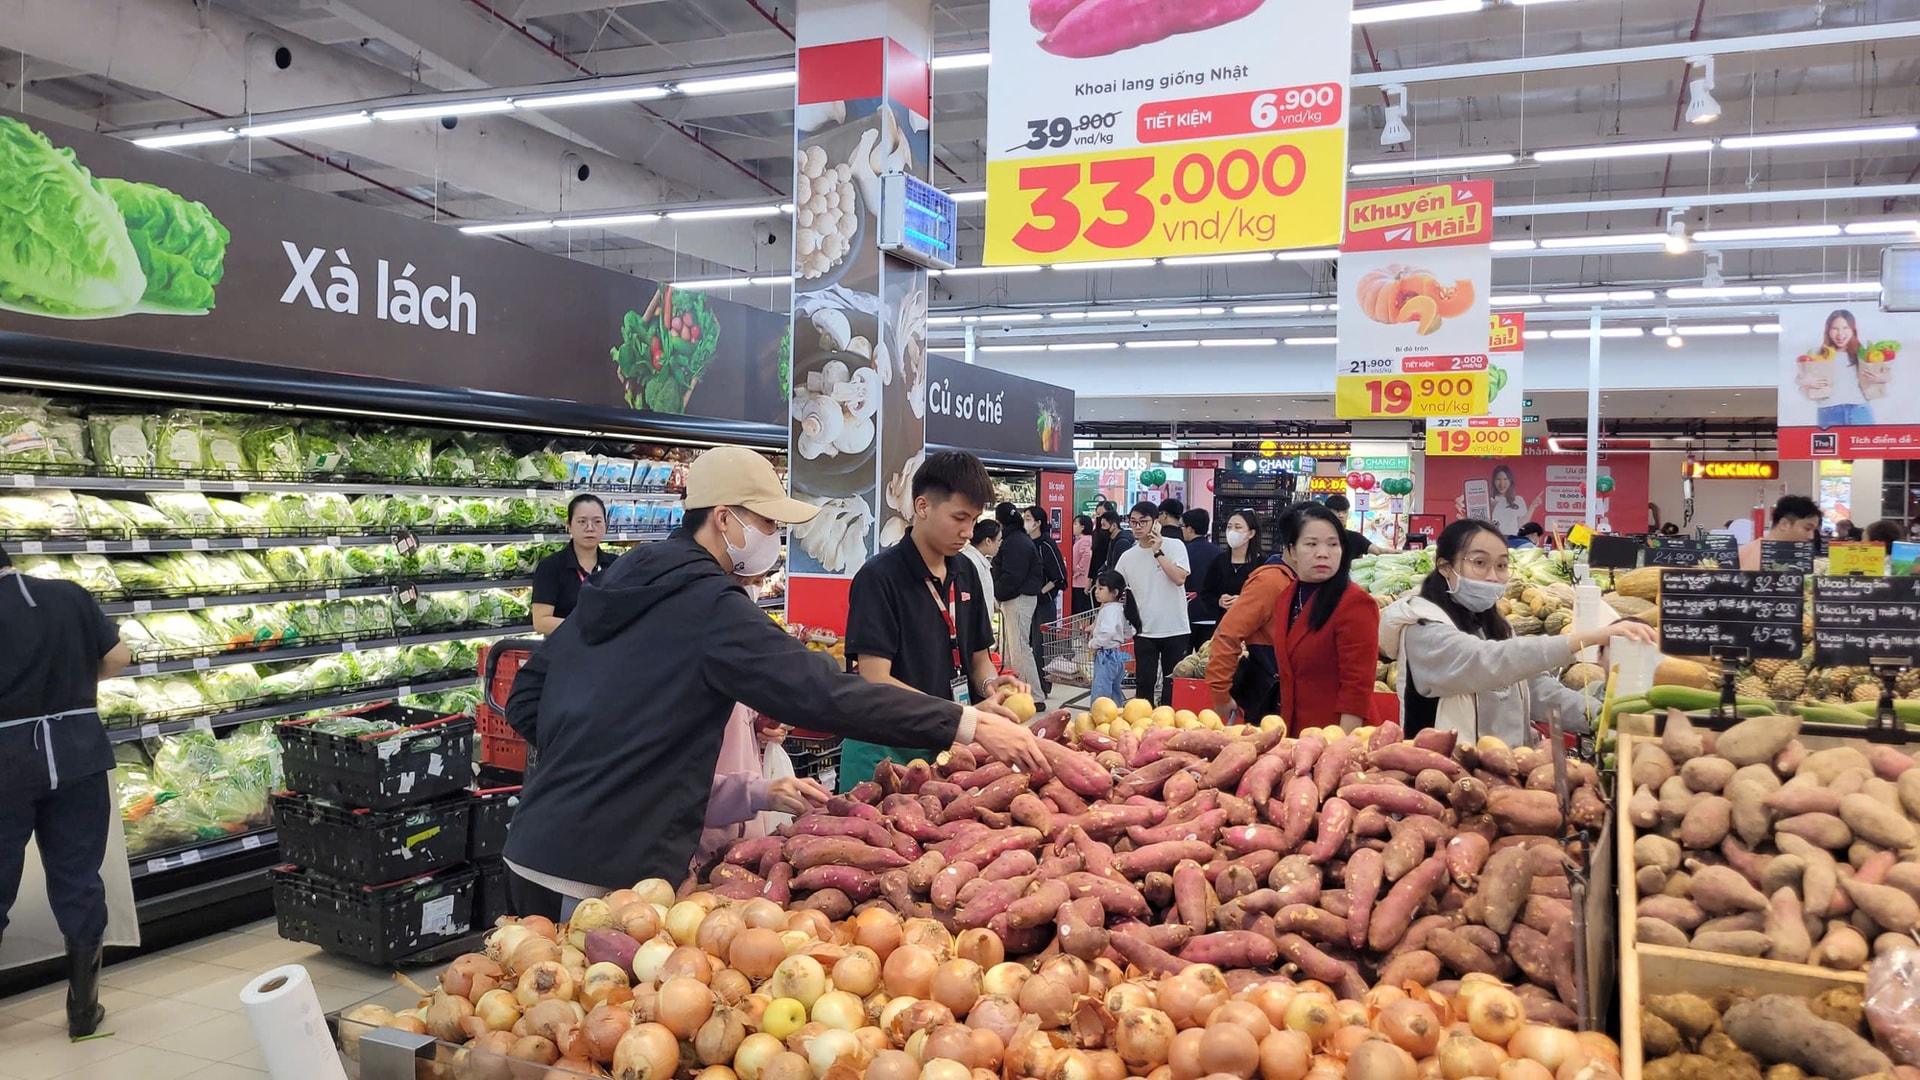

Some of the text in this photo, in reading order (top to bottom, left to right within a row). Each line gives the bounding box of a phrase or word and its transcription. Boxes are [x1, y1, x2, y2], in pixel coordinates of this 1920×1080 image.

[1075, 65, 1249, 96] Khoai lang giống Nhật
[1144, 109, 1212, 130] TIẾT KIỆM
[1281, 110, 1322, 124] vnd/kg
[1074, 133, 1114, 146] vnd/kg
[1011, 144, 1307, 254] 33.000 vnd/kg
[1353, 192, 1445, 225] Khuyến
[1421, 205, 1477, 239] Mãi!
[279, 240, 477, 335] Xà lách
[1489, 328, 1515, 347] ãi!
[928, 378, 1005, 425] Củ sơ chế
[1419, 401, 1470, 414] vnd/kg
[1437, 430, 1510, 452] 19.000
[1074, 450, 1147, 470] Ladofoods
[1366, 458, 1396, 466] CHANG
[1310, 480, 1327, 490] UA
